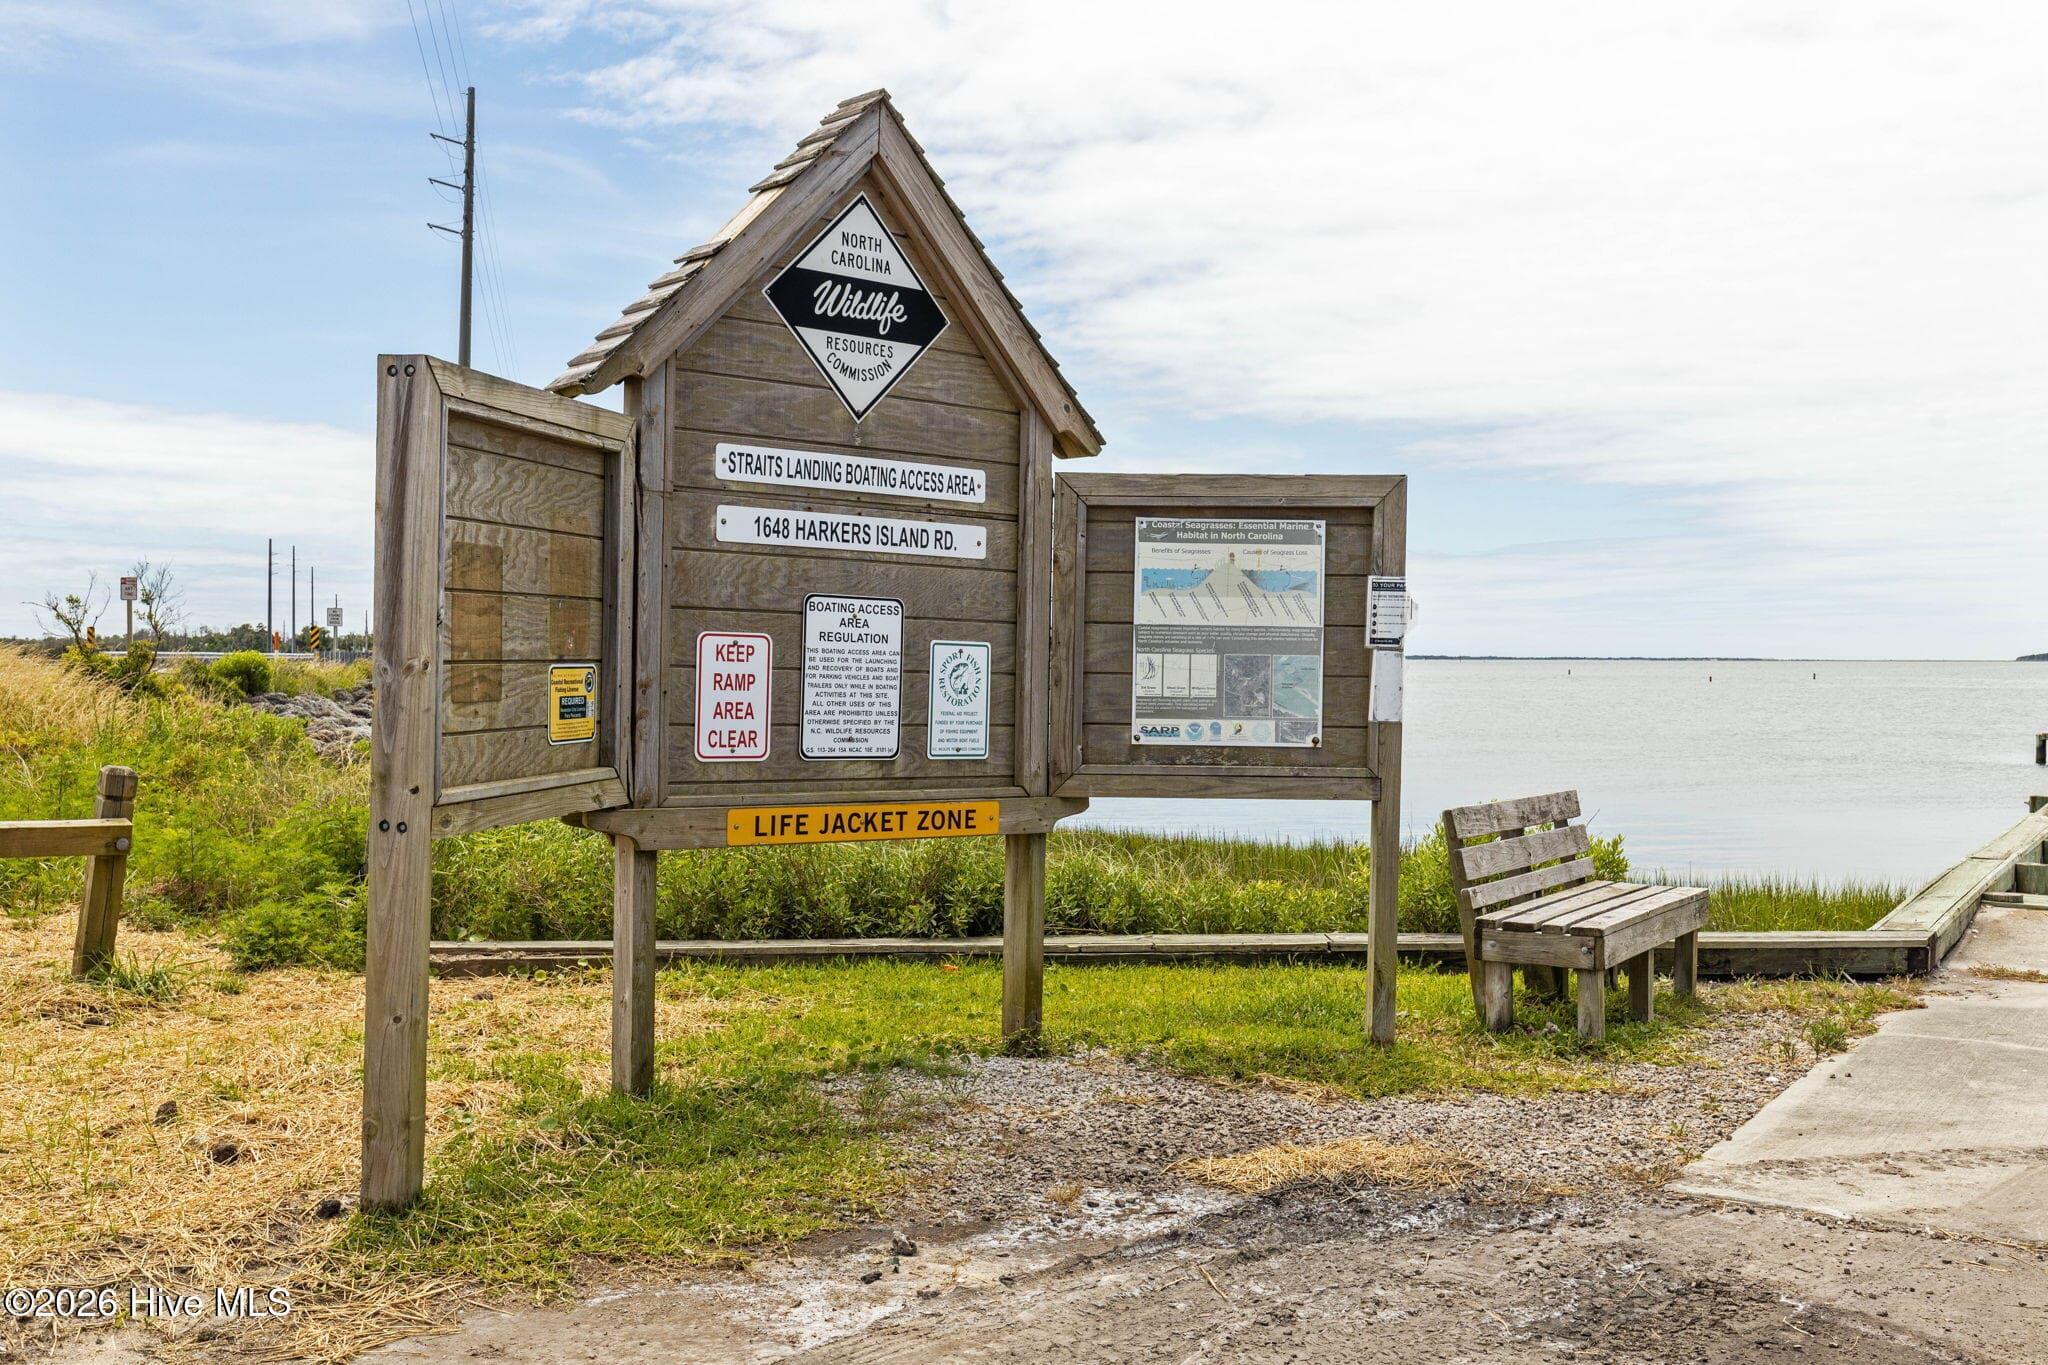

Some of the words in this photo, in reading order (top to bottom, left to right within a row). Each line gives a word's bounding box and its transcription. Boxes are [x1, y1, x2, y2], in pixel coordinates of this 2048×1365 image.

[842, 231, 882, 254] NORTH
[831, 250, 891, 275] CAROLINA
[813, 280, 907, 335] Wildlife
[826, 336, 894, 358] RESOURCES
[826, 352, 892, 382] COMMISSION
[728, 451, 783, 478] STRAITS
[786, 459, 842, 483] LANDING
[845, 464, 896, 488] BOATING
[899, 469, 944, 493] ACCESS
[946, 475, 976, 496] AREA
[754, 516, 790, 539] 1648
[796, 519, 871, 545] HARKERS
[876, 524, 930, 548] ISLAND
[934, 530, 958, 551] RD.
[1176, 531, 1208, 539] Habitat
[1248, 532, 1284, 540] Carolina
[1185, 522, 1236, 530] Seagrasses:
[808, 601, 855, 613] BOATING
[858, 604, 900, 616] ACCESS
[840, 618, 870, 628] AREA
[819, 631, 889, 644] REGULATION
[716, 644, 755, 662] KEEP
[940, 651, 962, 674] SPORT
[966, 654, 982, 674] FISH
[713, 672, 756, 691] RAMP
[562, 697, 585, 705] REQUIRED
[938, 678, 982, 707] RESTORATION
[712, 702, 754, 720] AREA
[708, 730, 758, 748] CLEAR
[1140, 726, 1180, 734] SARP
[754, 814, 809, 837] LIFE
[818, 810, 908, 834] JACKET
[916, 808, 977, 831] ZONE
